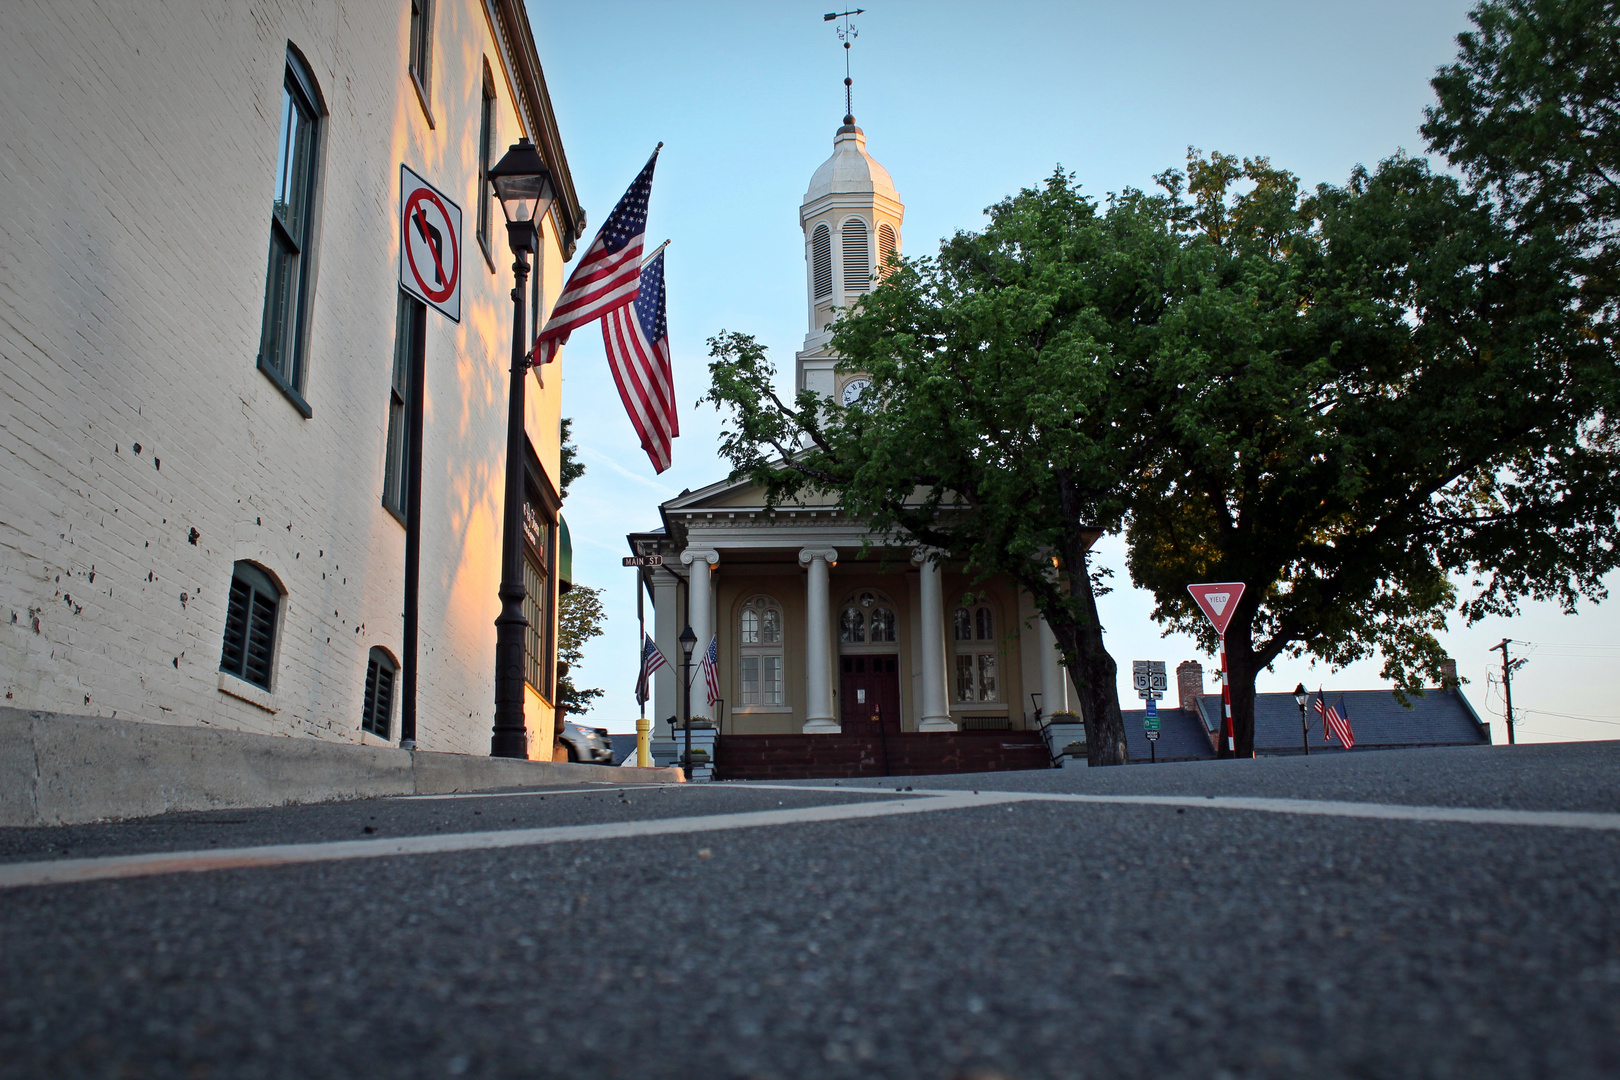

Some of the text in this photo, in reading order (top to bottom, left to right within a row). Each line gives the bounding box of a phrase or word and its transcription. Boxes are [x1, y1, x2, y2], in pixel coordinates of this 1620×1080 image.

[625, 556, 659, 566] MAIN ST
[1136, 676, 1146, 687] 15
[1153, 676, 1166, 687] 211
